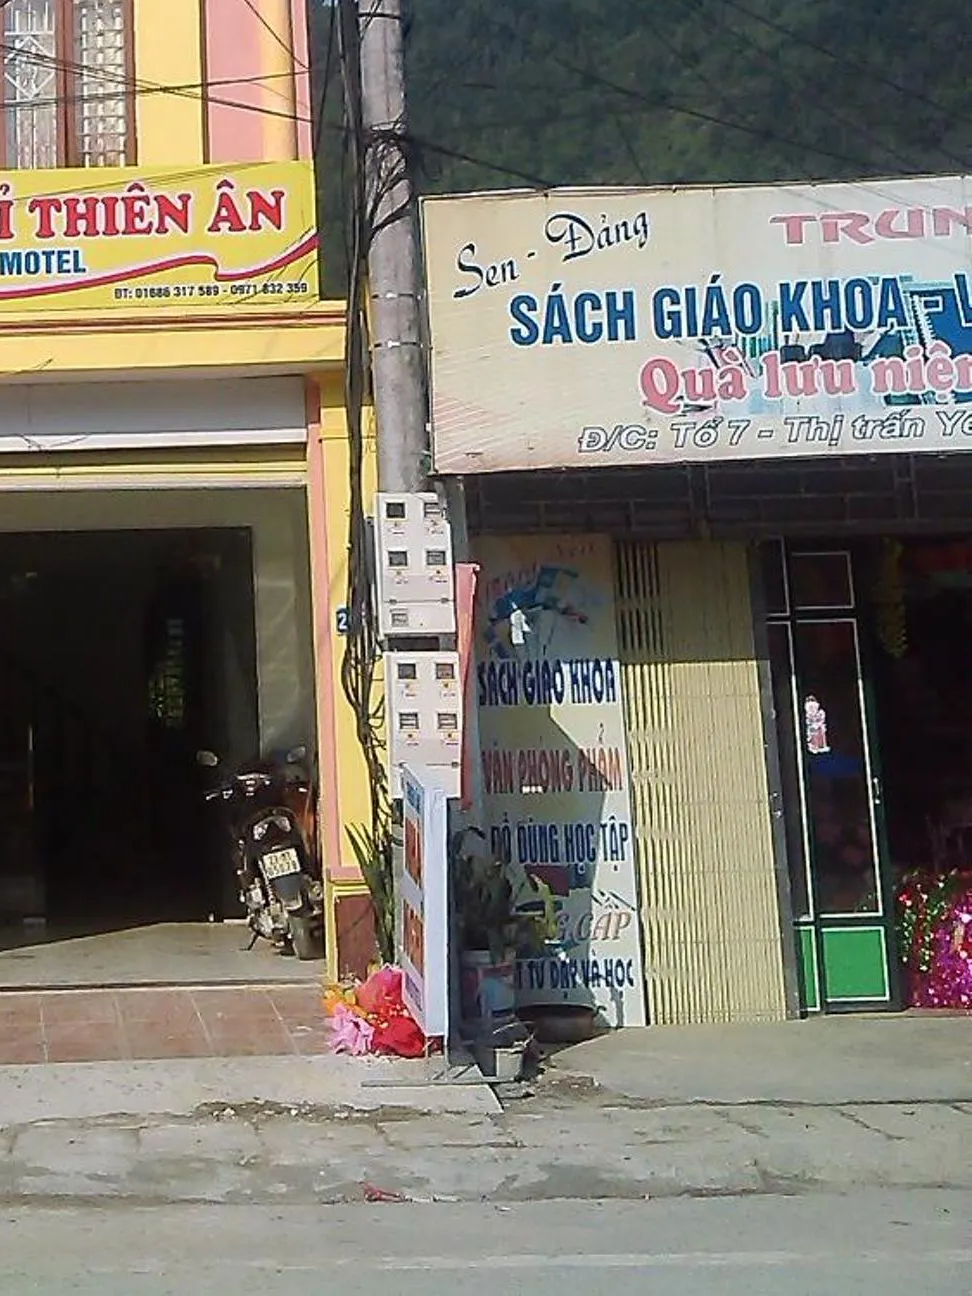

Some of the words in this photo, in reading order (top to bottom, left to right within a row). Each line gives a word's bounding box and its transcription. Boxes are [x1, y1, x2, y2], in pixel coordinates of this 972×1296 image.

[28, 183, 192, 240] THIÊN
[208, 179, 285, 232] ÂN
[0, 250, 86, 276] MOTEL
[453, 243, 520, 299] Sen
[510, 282, 636, 345] SÁCH
[653, 274, 762, 339] GIÁO
[779, 277, 909, 333] KHOA
[762, 352, 856, 398] lưu
[578, 424, 659, 454] Đ/C:
[669, 415, 724, 449] Tổ
[728, 418, 751, 447] 7
[784, 414, 845, 447] Thị
[851, 408, 926, 441] trấn
[570, 657, 617, 704] KHOA
[564, 823, 597, 872] HỌC
[600, 815, 629, 872] TẬP
